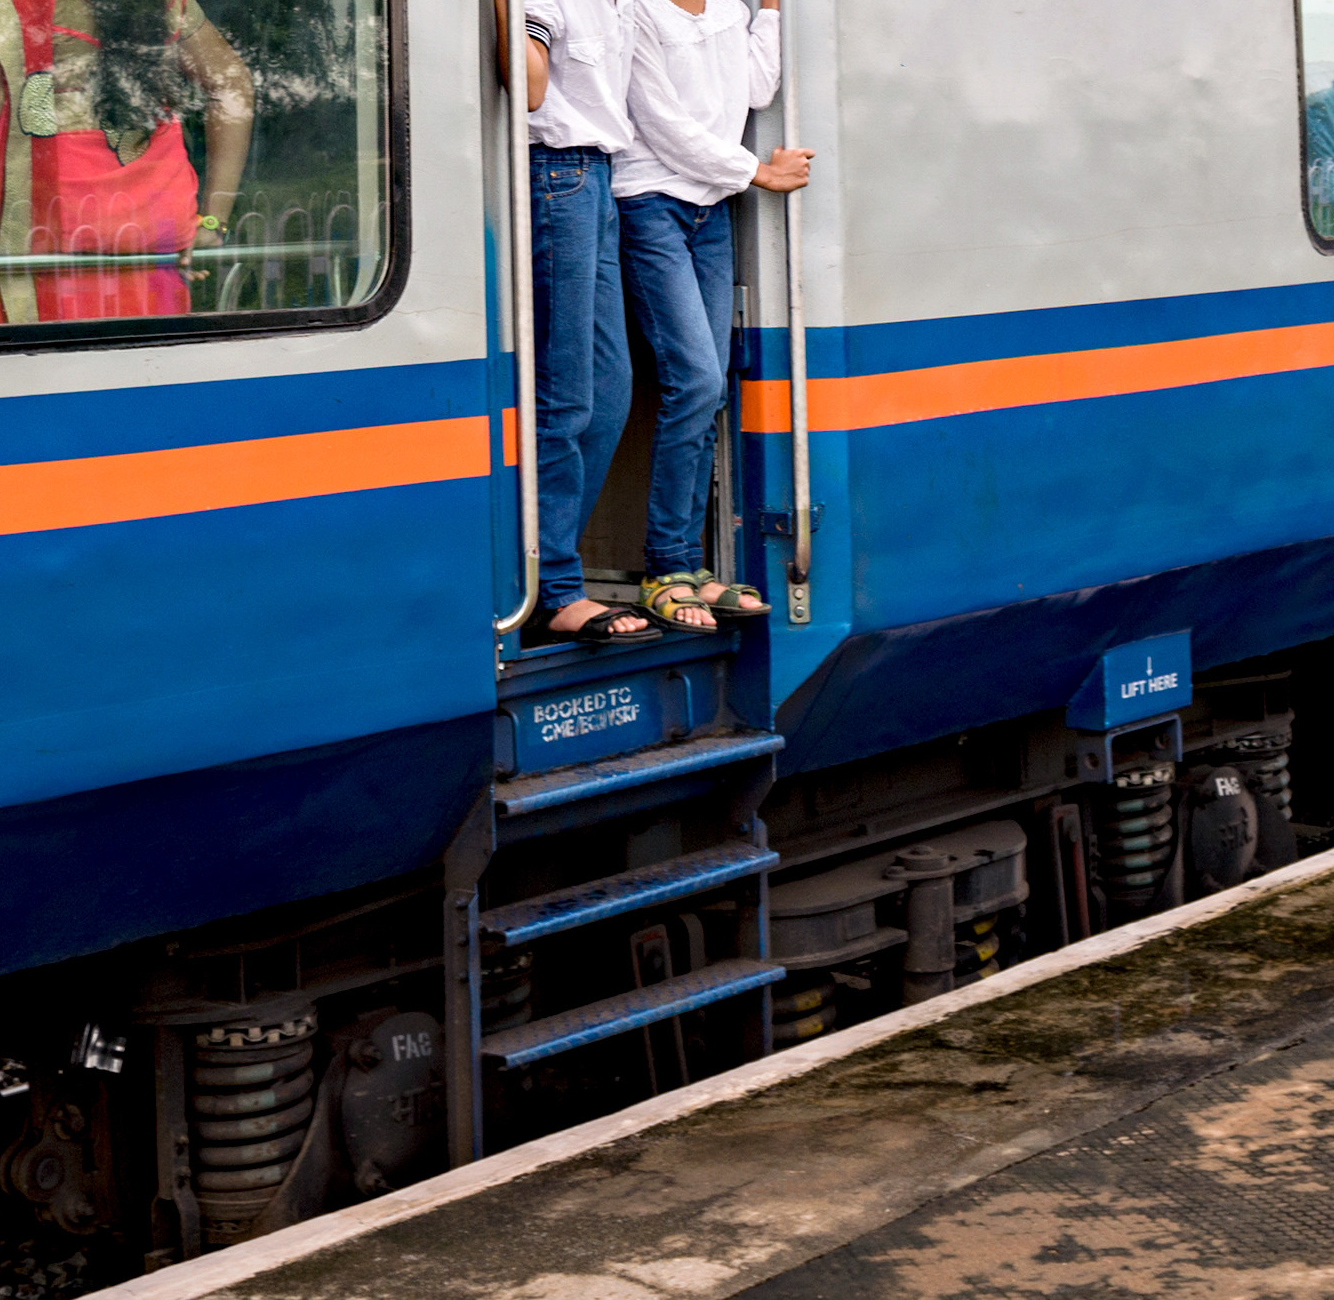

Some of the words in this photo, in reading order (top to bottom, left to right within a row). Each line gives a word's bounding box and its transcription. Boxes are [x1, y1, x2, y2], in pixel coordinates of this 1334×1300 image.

[1120, 679, 1147, 699] LIFT
[1147, 672, 1178, 694] HERE
[533, 692, 607, 724] BOOKED
[607, 686, 633, 707] TO
